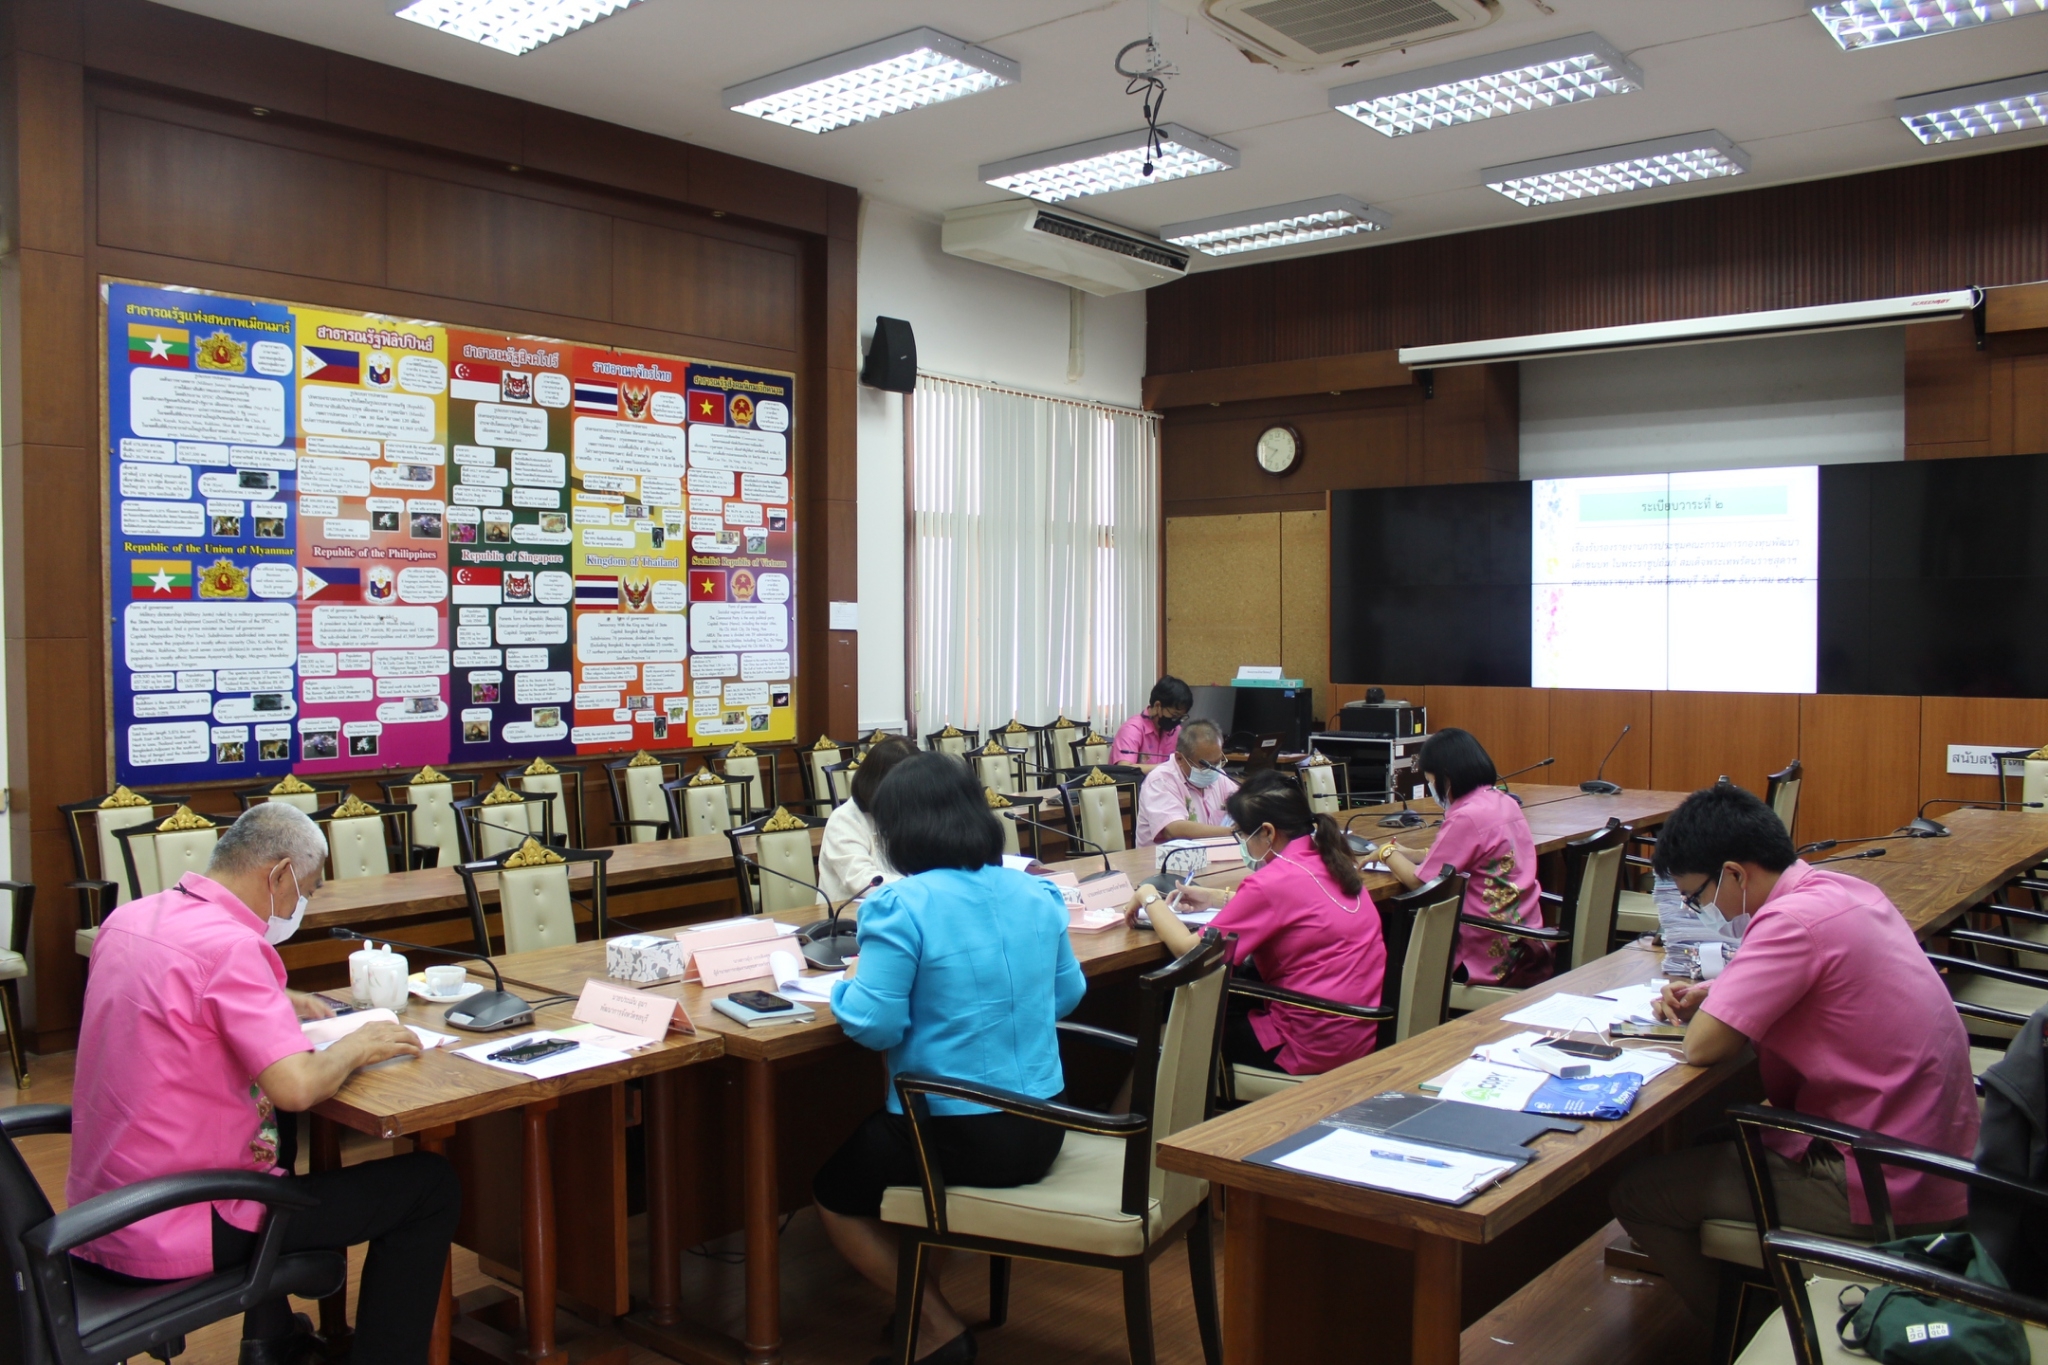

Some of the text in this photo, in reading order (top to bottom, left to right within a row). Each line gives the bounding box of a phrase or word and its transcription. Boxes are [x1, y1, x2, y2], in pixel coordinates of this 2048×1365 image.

[126, 304, 291, 334] สาธารณรัฐแห่งสหภาพเมียนมาร์
[317, 325, 434, 352] สาธารณรัฐฟิลิปปินส์
[464, 344, 559, 368] สาธารณรัฐสิงคโปร์
[593, 361, 671, 382] ราชอาณาจักรไทย
[1715, 500, 1723, 509] ๒
[124, 542, 294, 557] Republic of the Union of Myanmar
[313, 547, 437, 561] Republic of the Philippines
[462, 550, 563, 565] Republic of Singapore
[586, 555, 679, 568] Kingdom of Thailand
[692, 556, 787, 567] Socialist Republic of Vietnam
